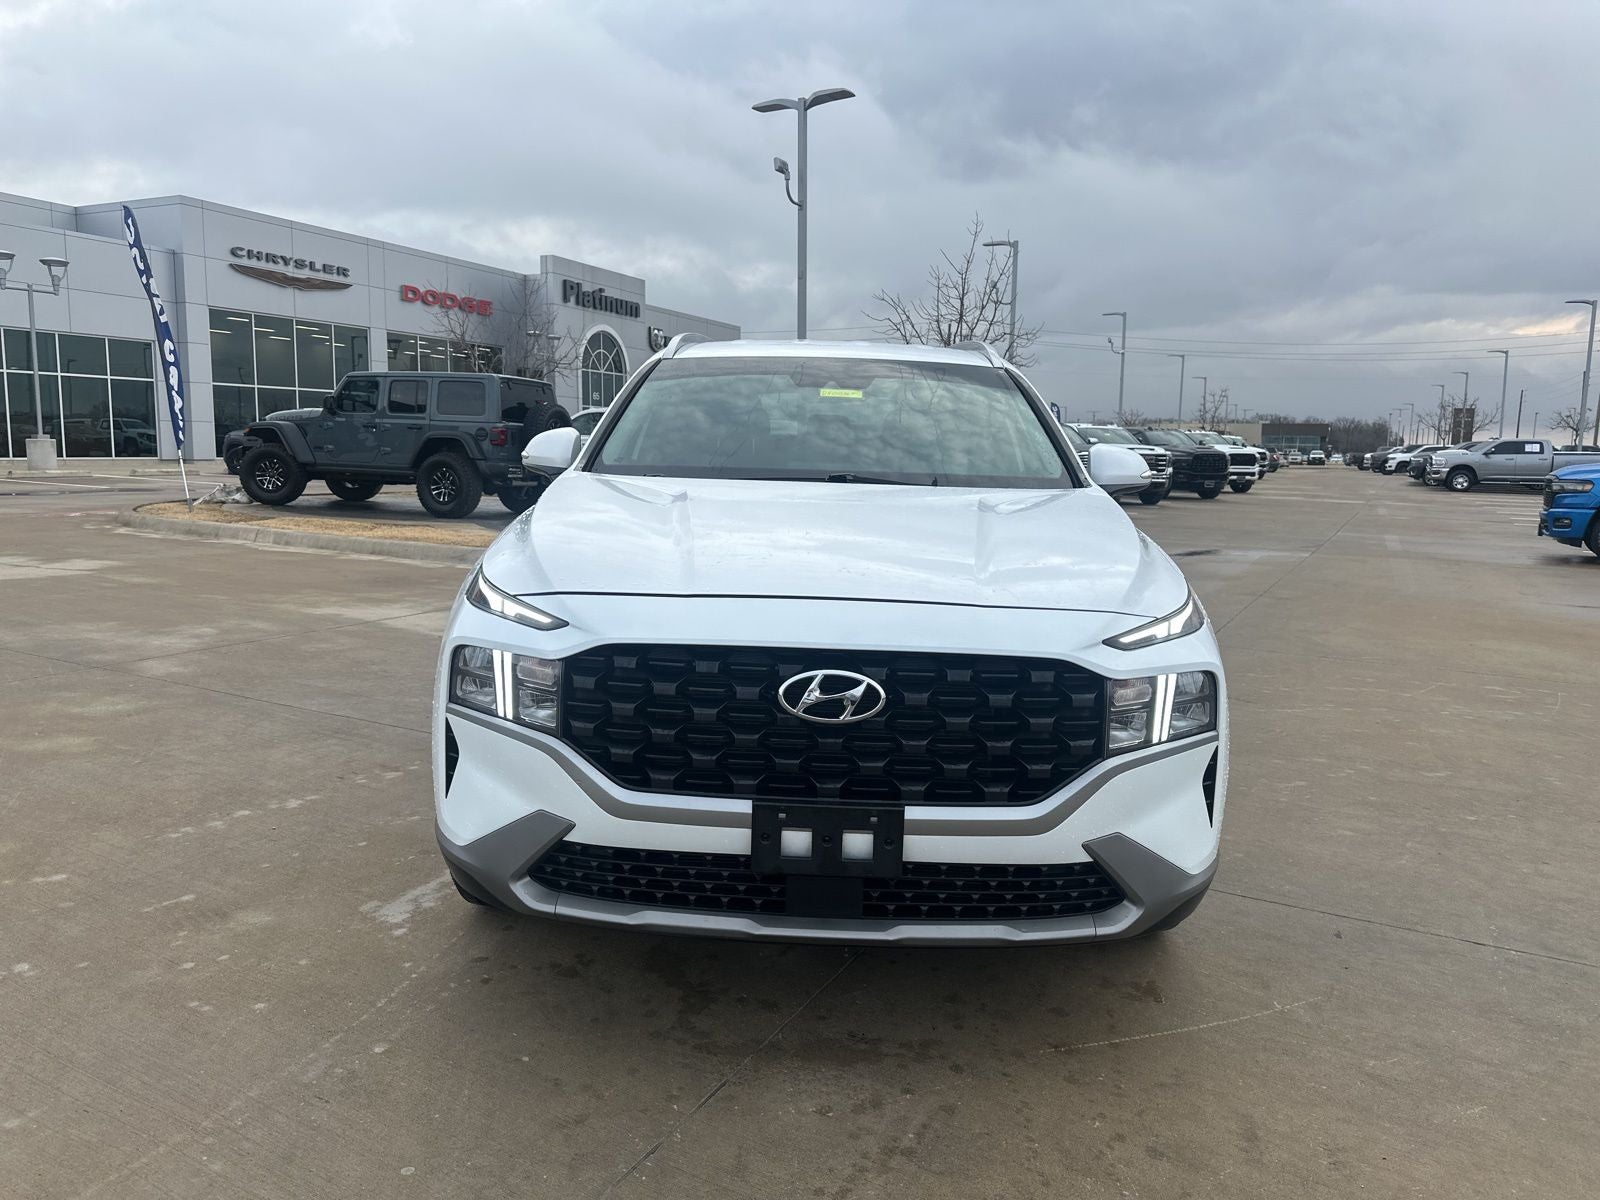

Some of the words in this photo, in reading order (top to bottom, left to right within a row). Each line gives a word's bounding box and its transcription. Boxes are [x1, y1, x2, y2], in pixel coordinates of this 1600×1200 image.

[229, 246, 351, 278] CHRYSLER
[400, 284, 493, 316] DODGE
[562, 279, 641, 319] Platinum
